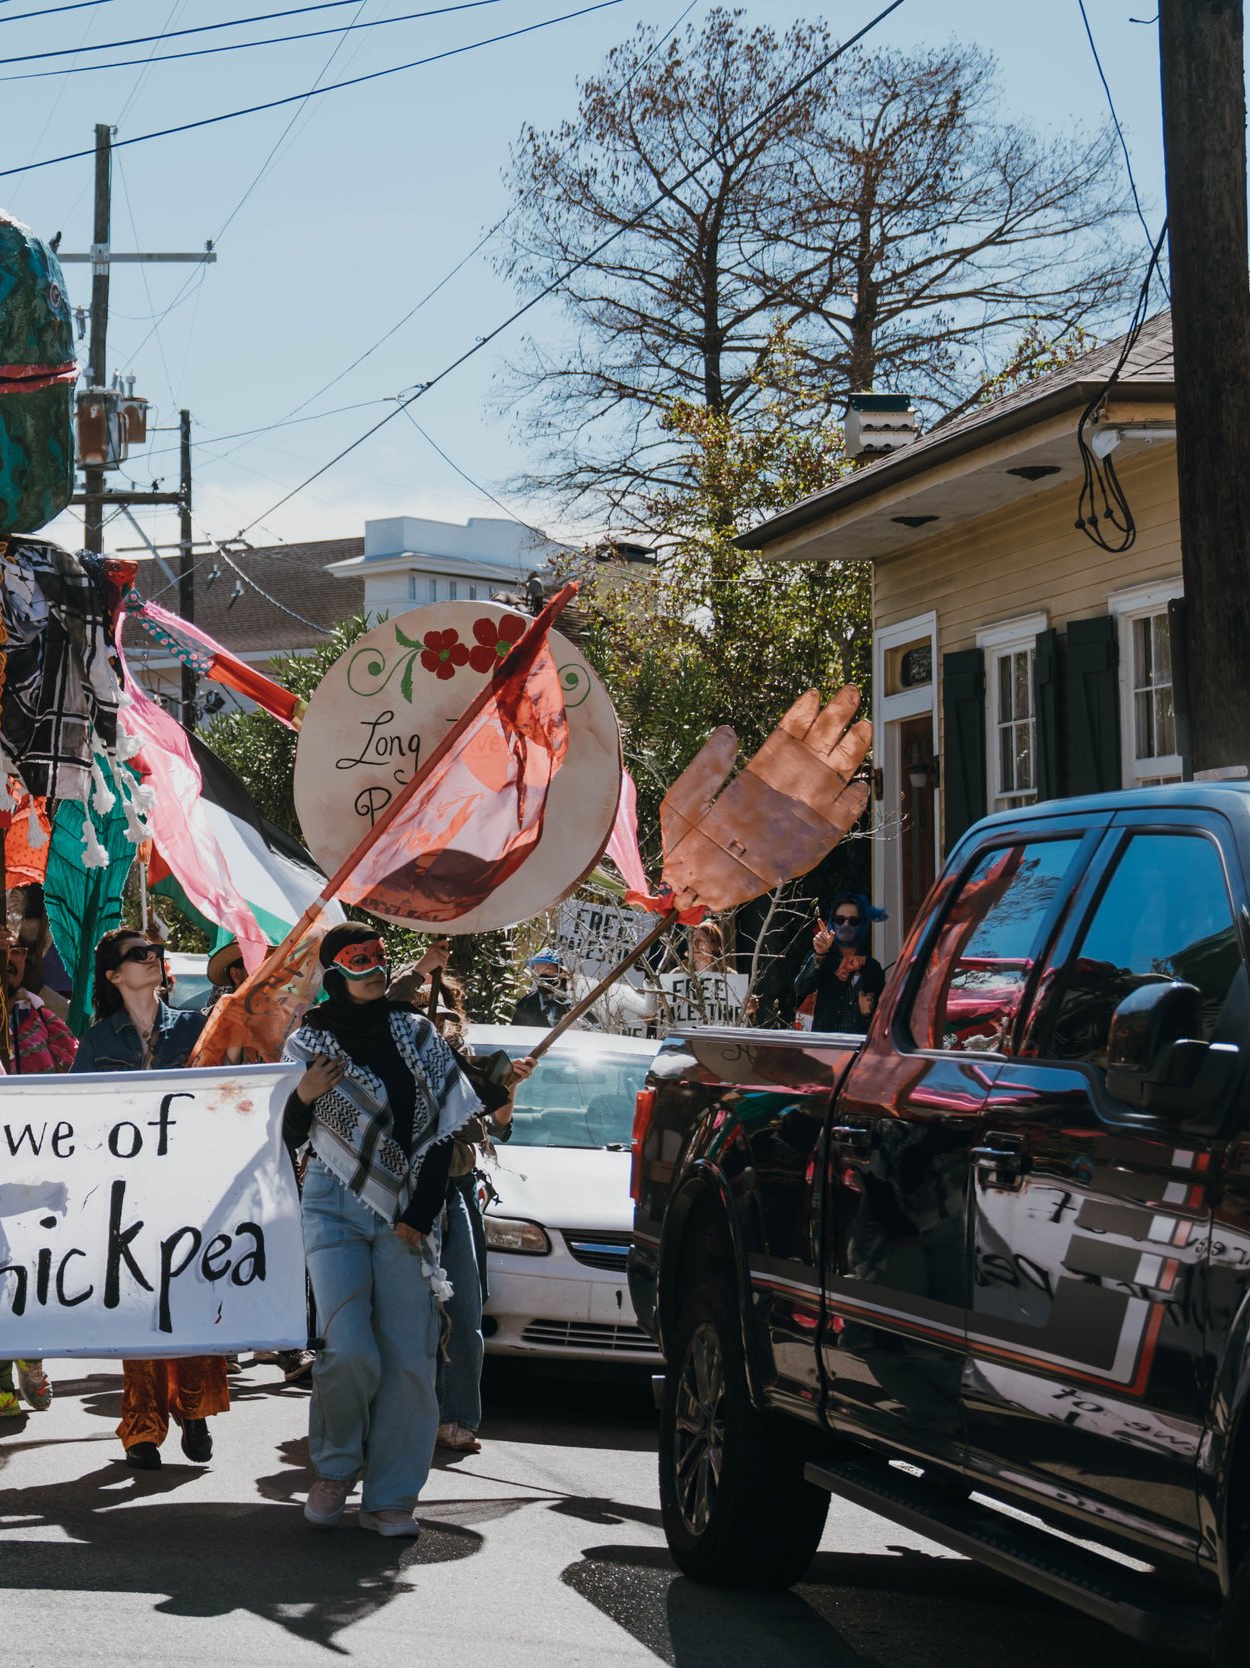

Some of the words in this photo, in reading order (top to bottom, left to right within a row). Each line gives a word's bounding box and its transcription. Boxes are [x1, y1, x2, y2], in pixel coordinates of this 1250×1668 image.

[335, 710, 421, 785] Long
[574, 909, 634, 943] FREE
[672, 977, 727, 1003] FREE
[107, 1092, 196, 1160] of
